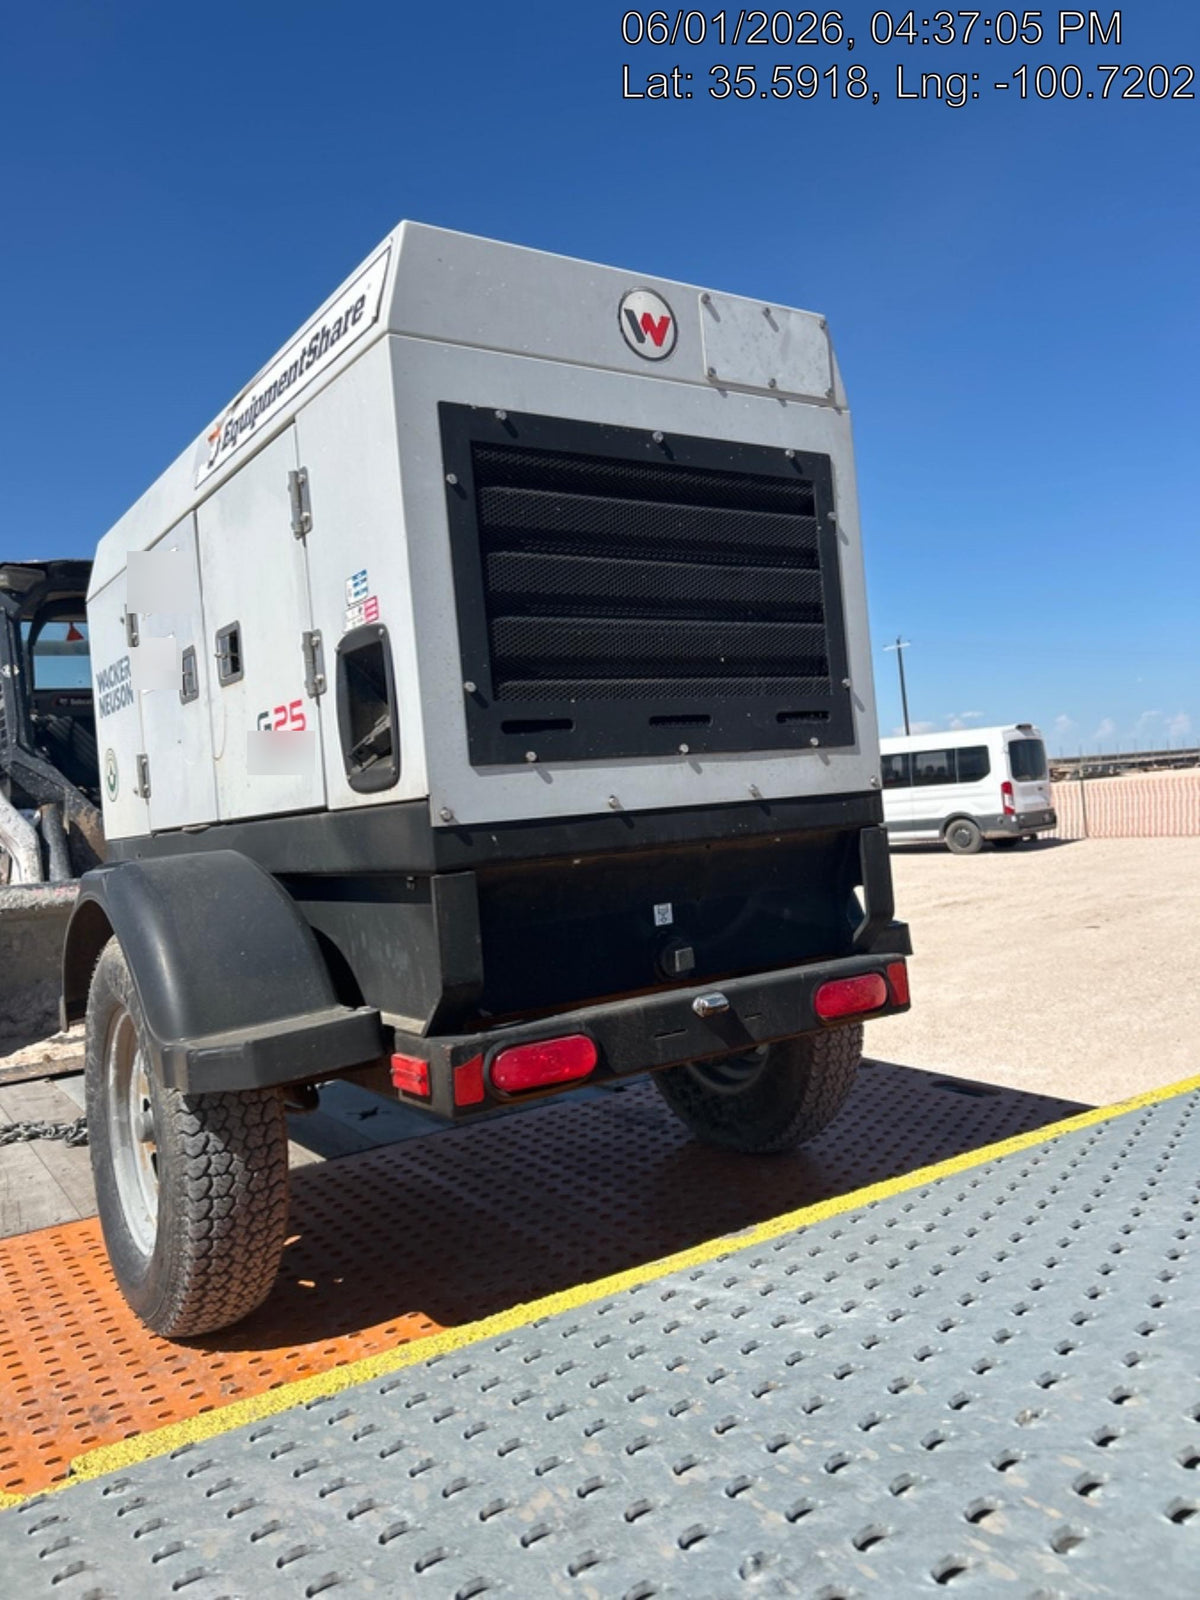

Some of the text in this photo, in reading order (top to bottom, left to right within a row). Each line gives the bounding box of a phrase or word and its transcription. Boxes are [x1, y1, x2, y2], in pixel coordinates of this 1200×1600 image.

[220, 294, 367, 453] EquipmentShare
[96, 656, 131, 693] WACKER
[99, 681, 134, 719] NEUSON
